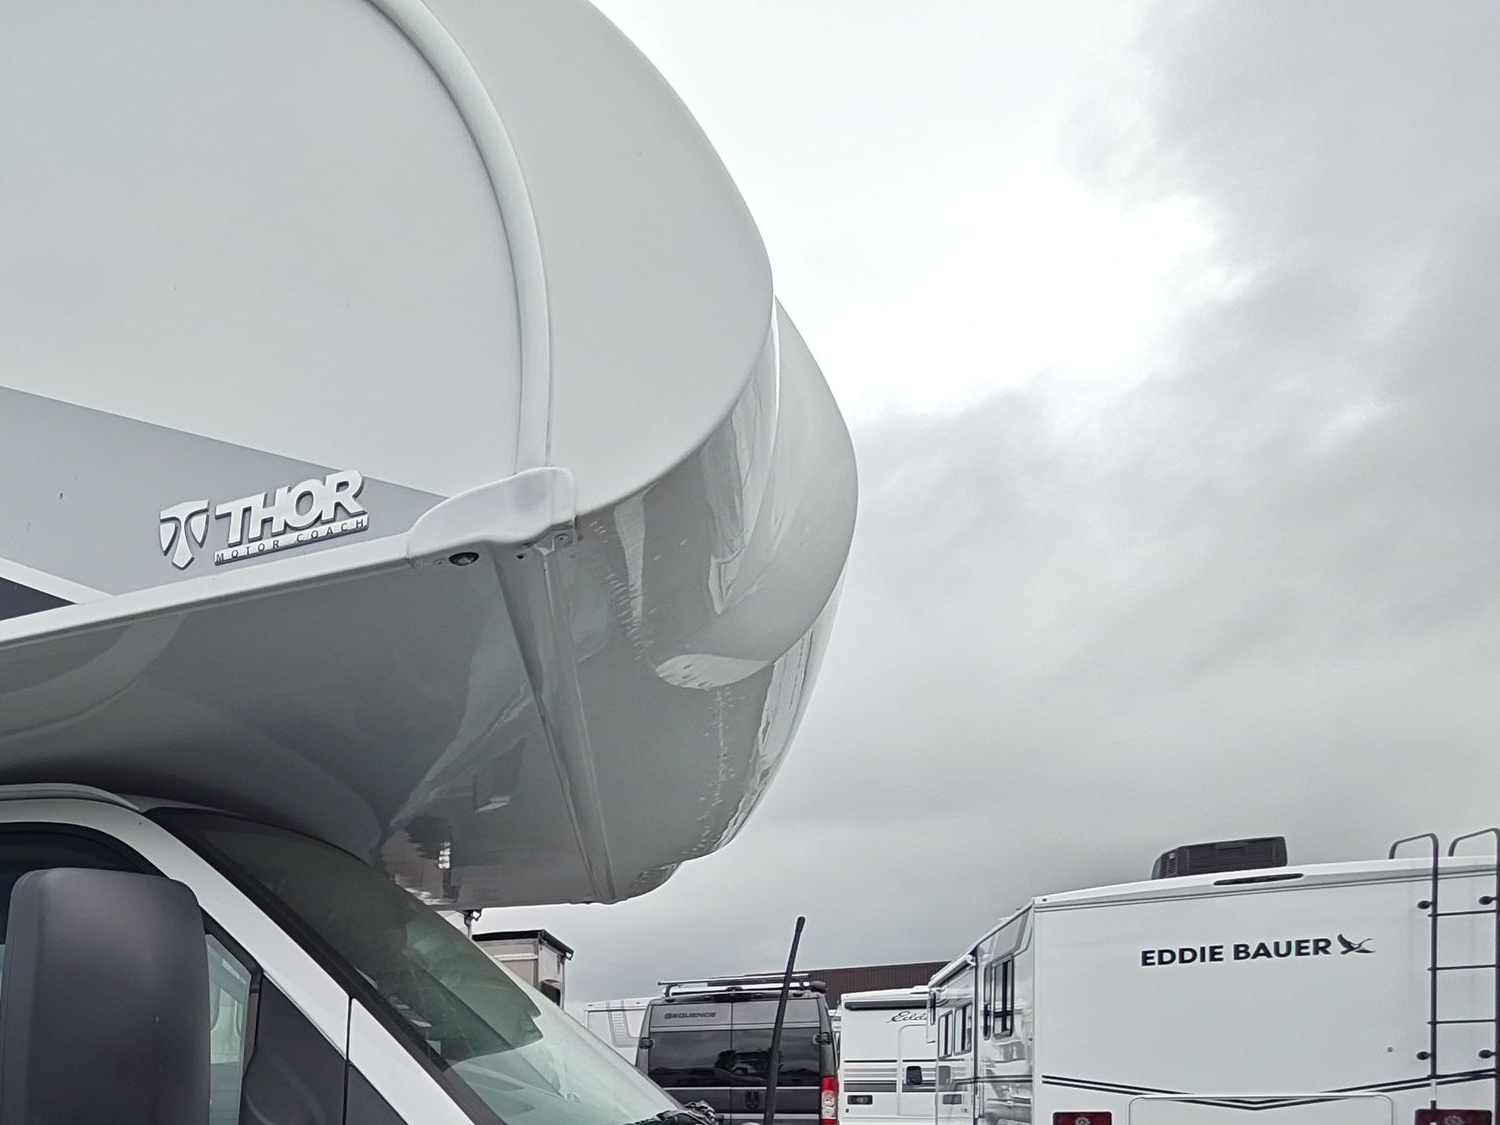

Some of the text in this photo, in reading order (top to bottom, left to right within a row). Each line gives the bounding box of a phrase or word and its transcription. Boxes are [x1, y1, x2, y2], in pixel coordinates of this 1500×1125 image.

[214, 469, 366, 548] THOR
[215, 518, 368, 563] MOTOR COACH
[1141, 938, 1332, 967] EDDIE BAUER
